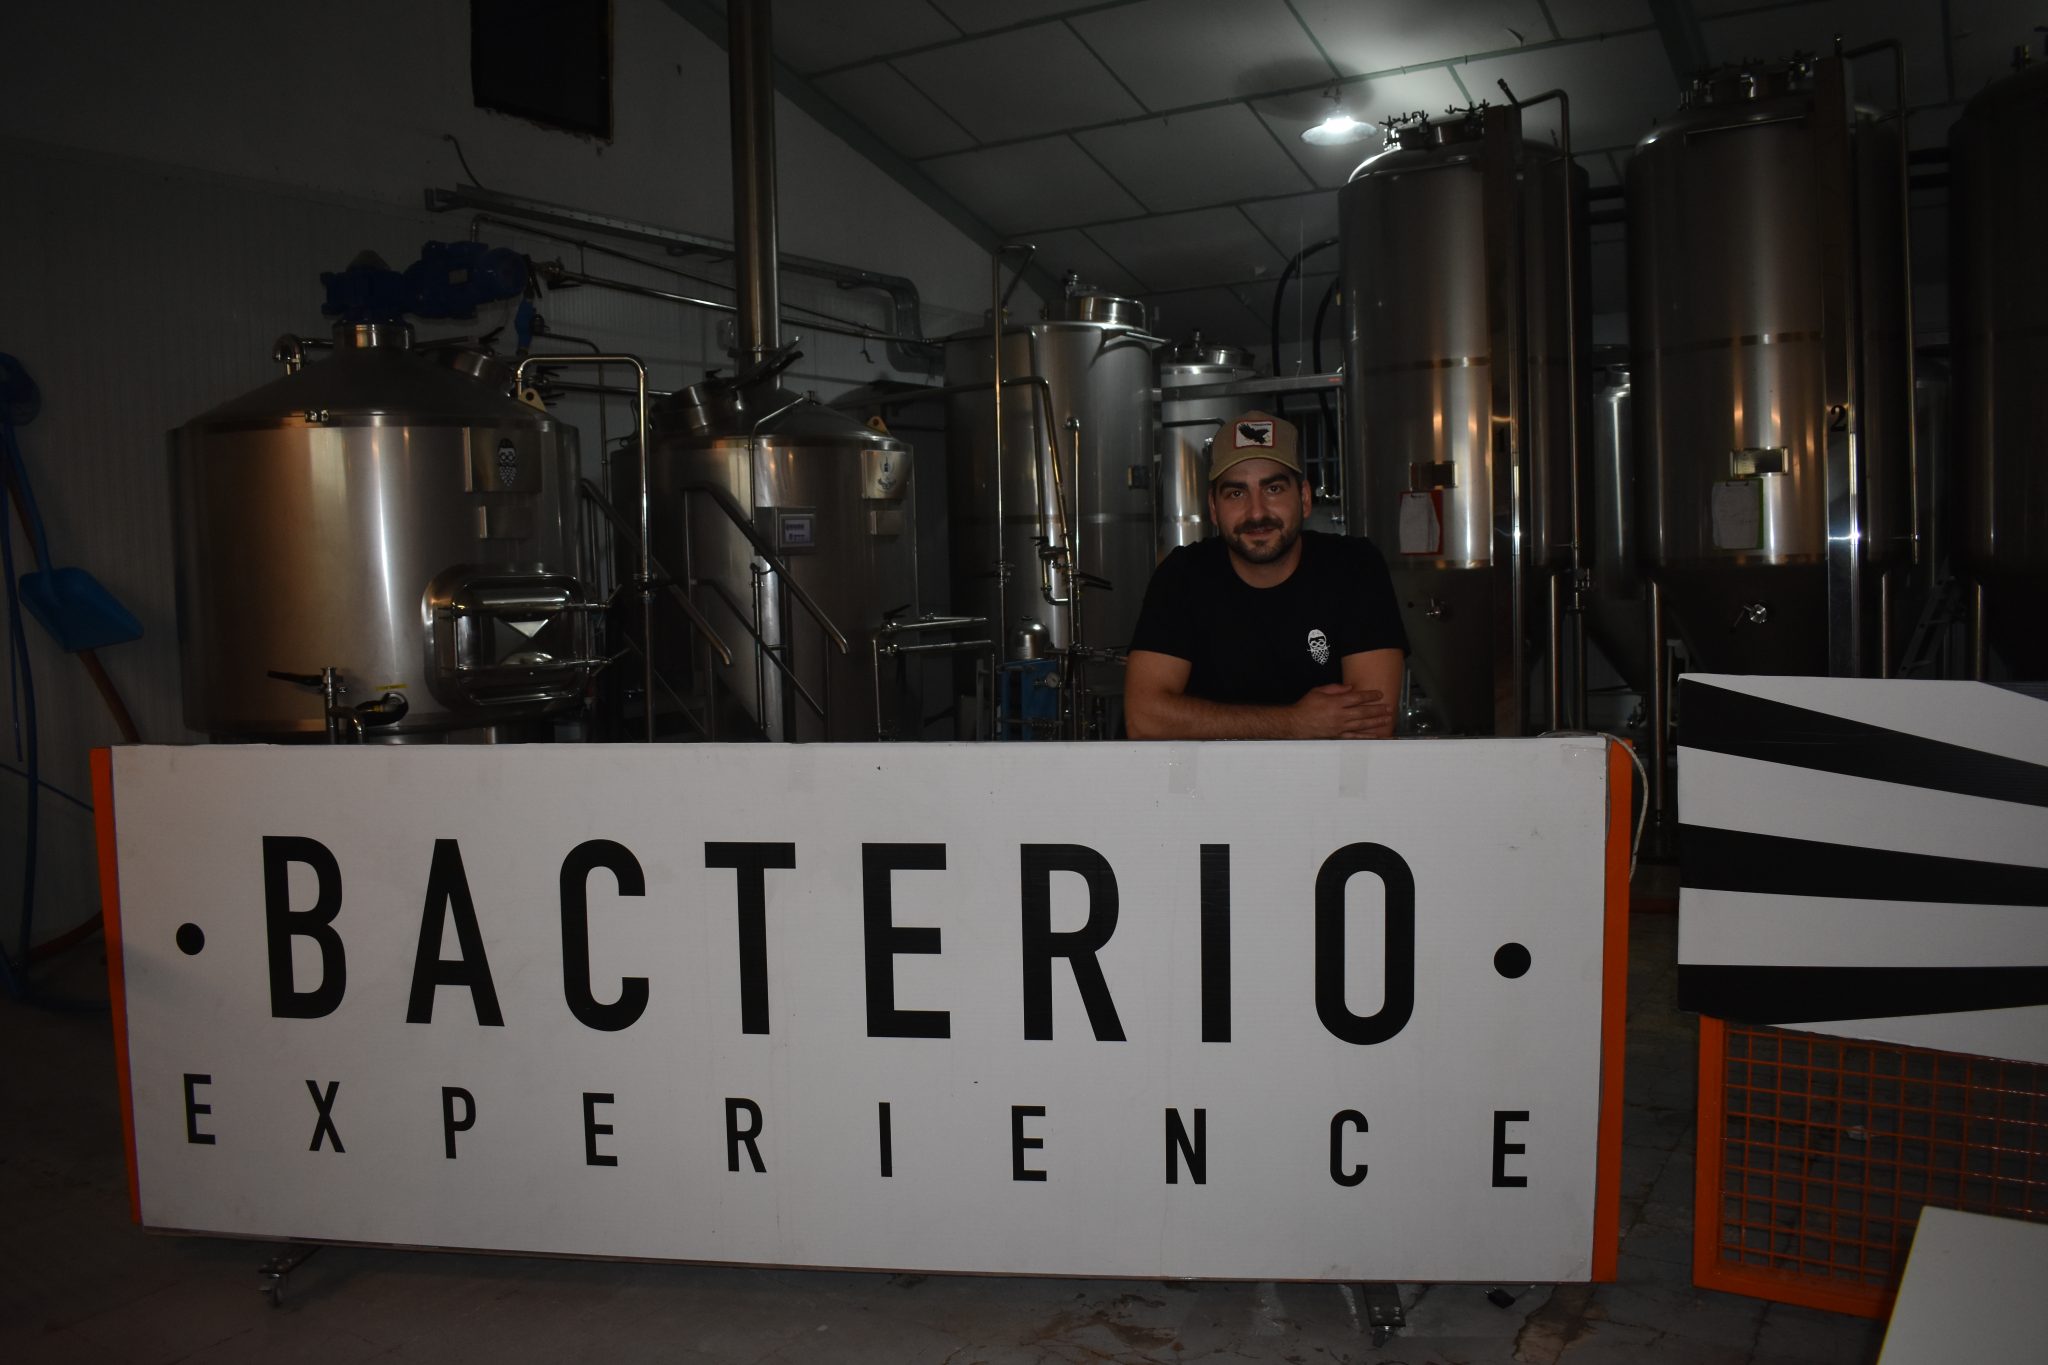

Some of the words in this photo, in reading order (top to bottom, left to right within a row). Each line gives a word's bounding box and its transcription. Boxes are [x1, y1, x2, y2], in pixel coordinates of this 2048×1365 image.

[1830, 404, 1847, 432] 2
[262, 835, 1416, 1046] BACTERIO
[183, 1073, 1530, 1188] EXPERIENCE
